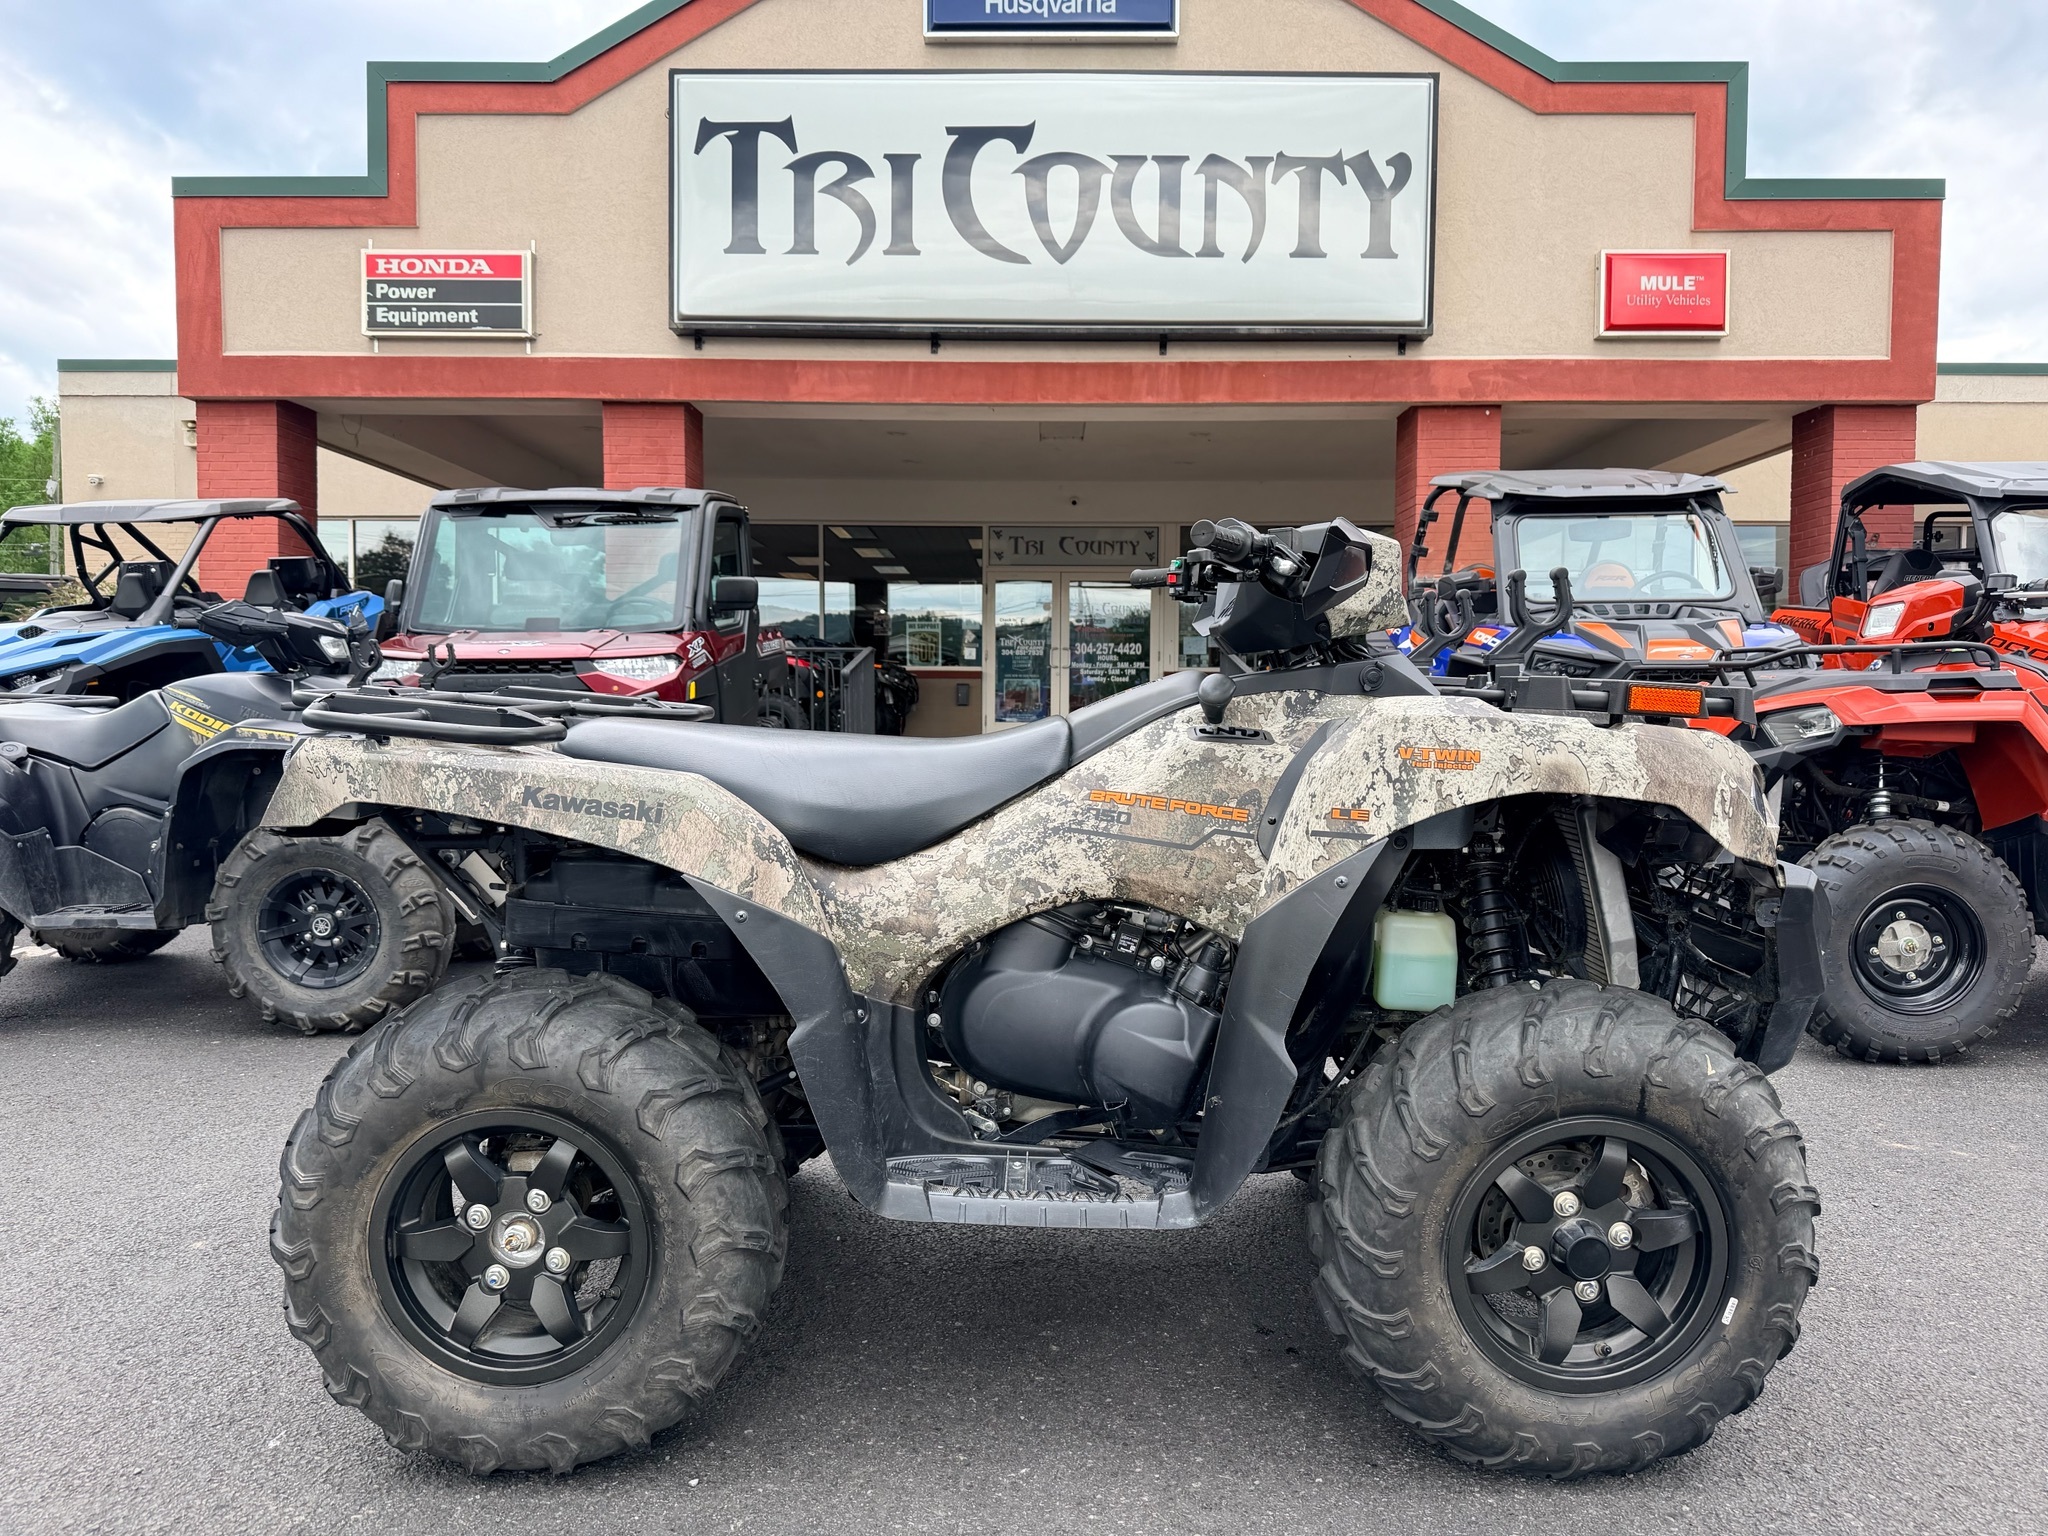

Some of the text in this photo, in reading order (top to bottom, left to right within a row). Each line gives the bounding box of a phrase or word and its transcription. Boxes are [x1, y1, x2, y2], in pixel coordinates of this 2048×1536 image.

[984, 0, 1116, 18] Husqvarna
[941, 120, 1412, 265] COUNTY
[375, 258, 494, 275] HONDA
[375, 283, 436, 299] Power
[1626, 294, 1711, 308] Utility Vehicles
[375, 307, 479, 326] Equipment
[1058, 536, 1140, 556] COUNTY
[1776, 614, 1822, 630] GENERAL
[1074, 642, 1142, 655] 304-257-4420
[1071, 661, 1092, 669] Monday
[1096, 661, 1113, 669] Friday
[1397, 746, 1481, 763] V-TWIN
[521, 785, 664, 824] Kawasaki
[696, 800, 720, 826] STRATA
[1089, 789, 1250, 822] BRUTE FORCE
[1087, 807, 1132, 825] 750
[1331, 807, 1370, 822] LE
